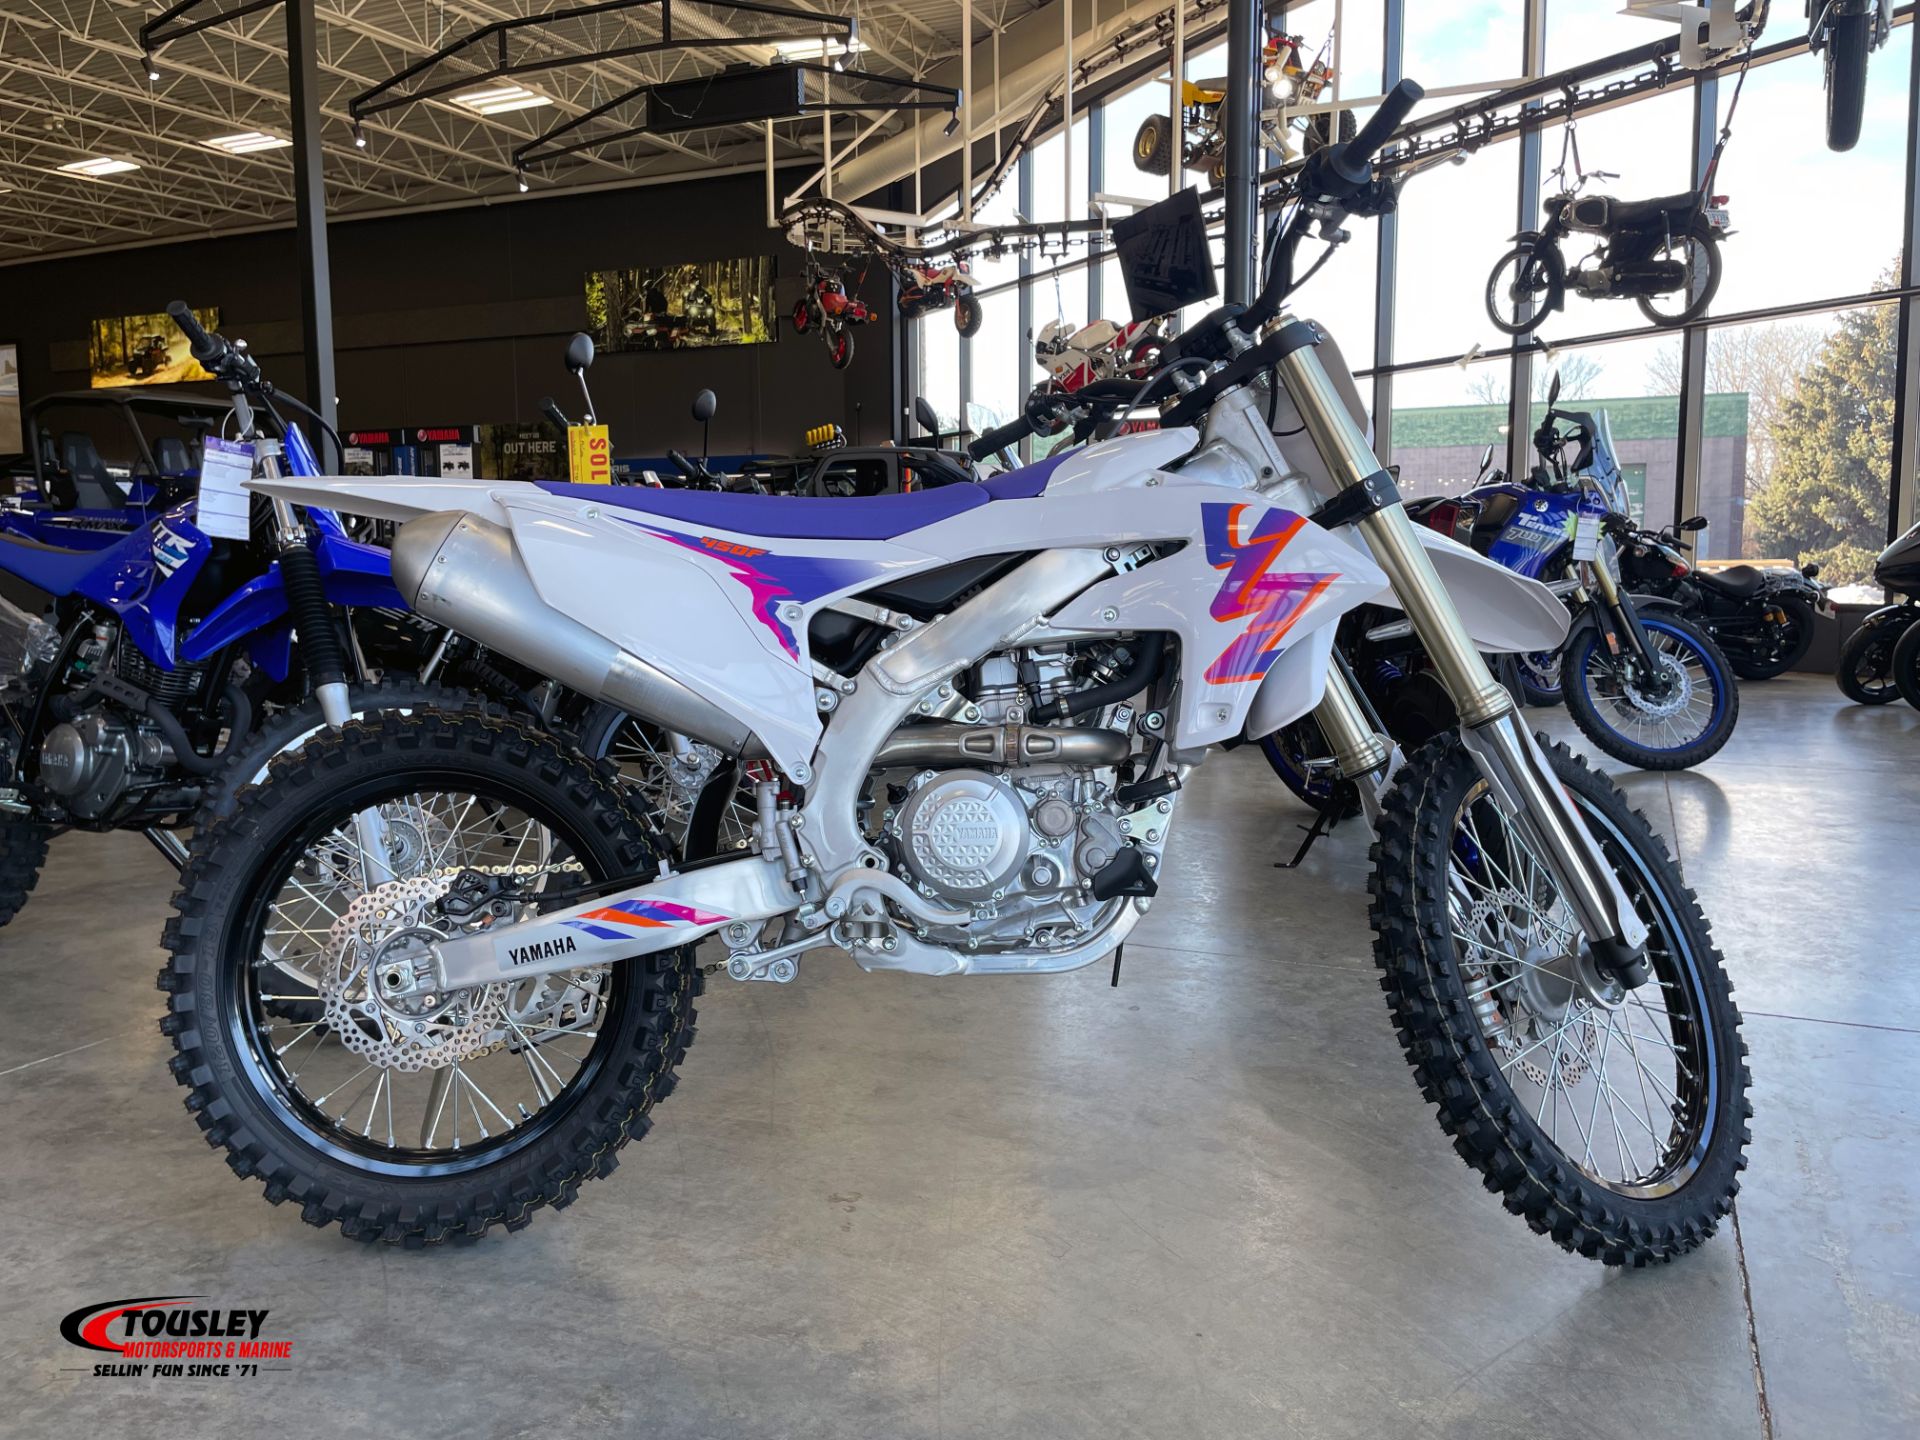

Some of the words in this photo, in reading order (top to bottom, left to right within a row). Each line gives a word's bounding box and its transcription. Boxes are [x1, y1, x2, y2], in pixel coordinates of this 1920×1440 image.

[503, 442, 525, 455] OUT
[528, 441, 557, 454] HERE
[590, 438, 608, 481] SOL
[1506, 527, 1542, 542] 700
[700, 536, 767, 558] 450F
[957, 827, 998, 839] YAMAHA
[508, 936, 577, 966] YAMAHA
